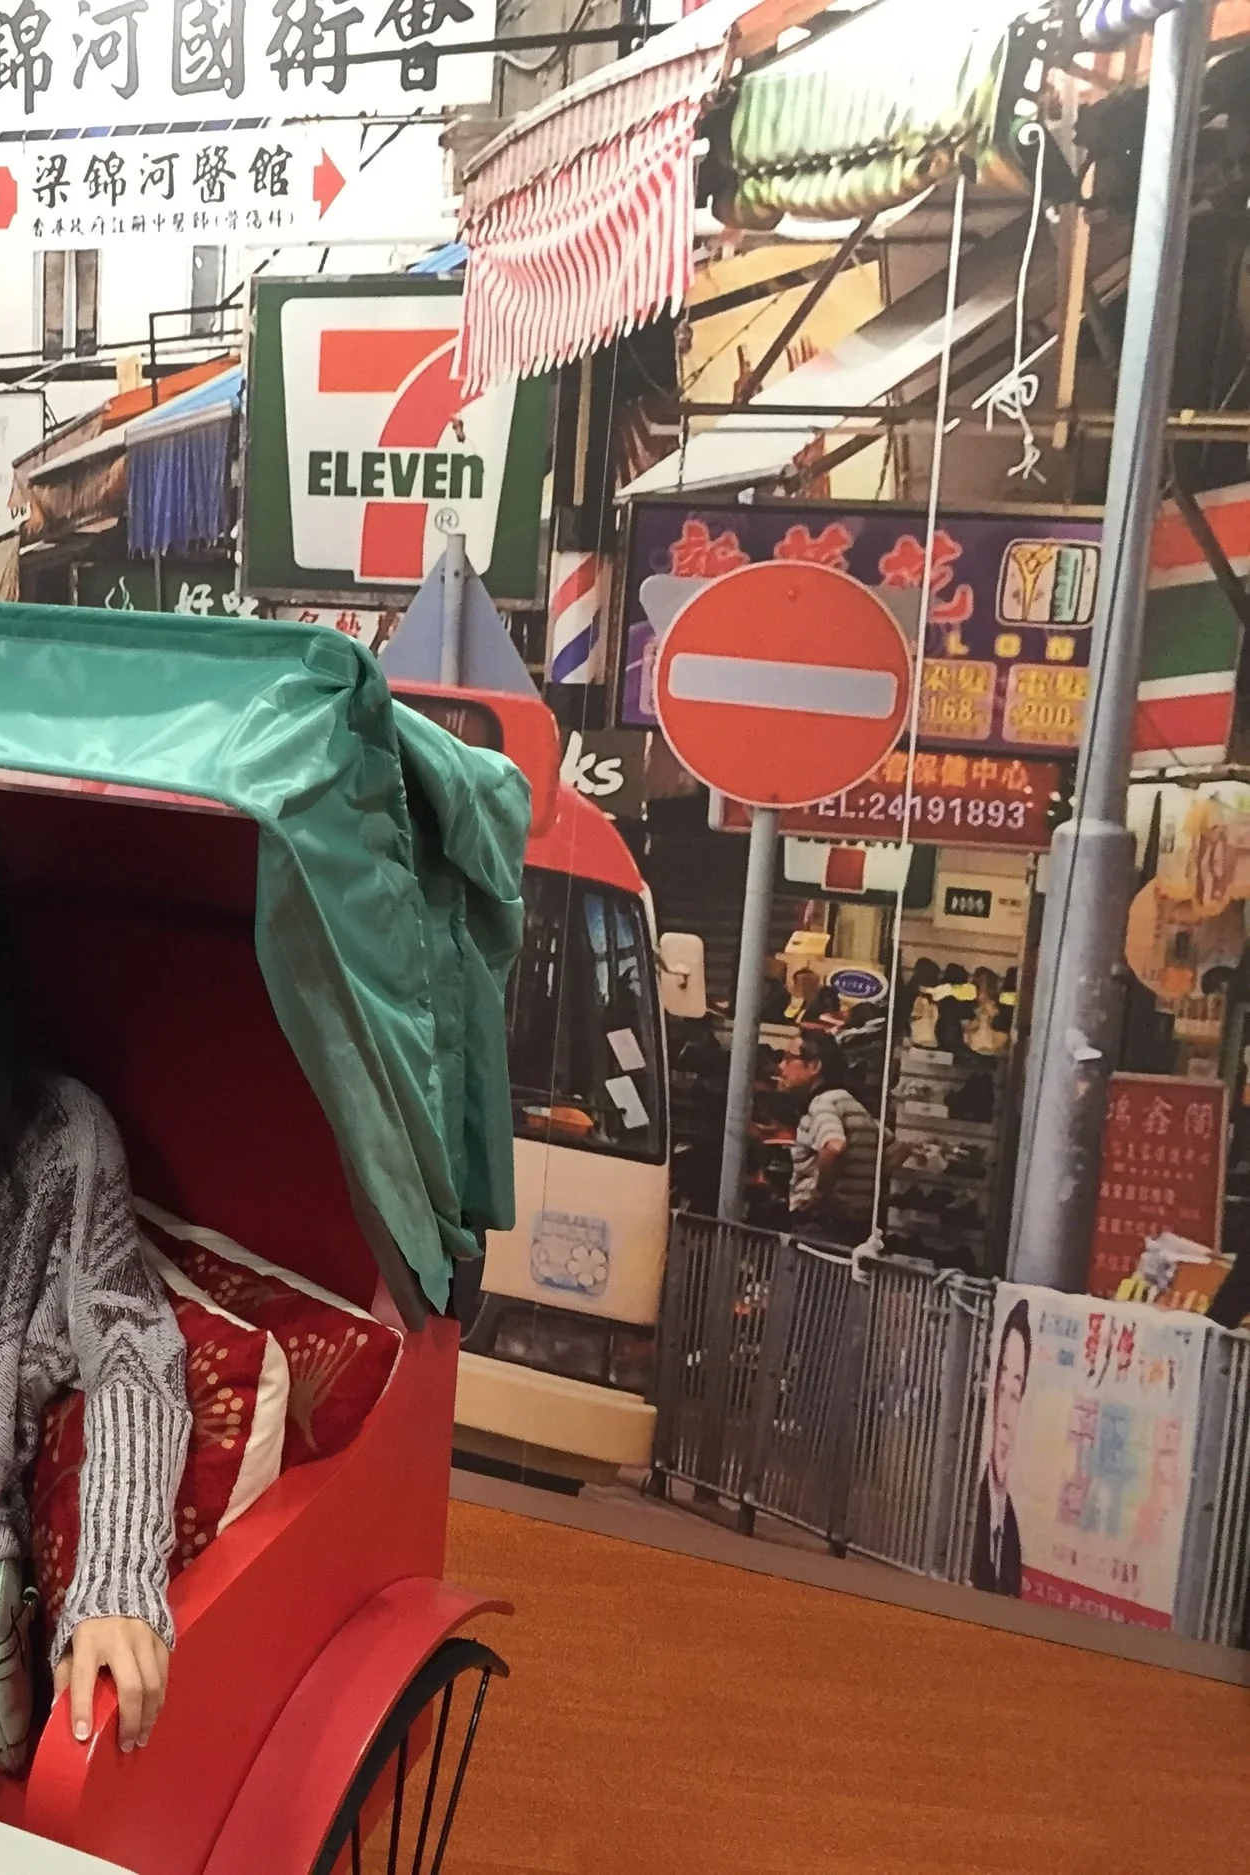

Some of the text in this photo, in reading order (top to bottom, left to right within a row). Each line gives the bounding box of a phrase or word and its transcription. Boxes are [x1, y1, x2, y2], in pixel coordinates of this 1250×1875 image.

[32, 144, 293, 208] 梁錦河醫館
[307, 450, 485, 500] ELEVEn
[869, 752, 1029, 791] 容保健中心
[802, 790, 1026, 830] EL:24191893
